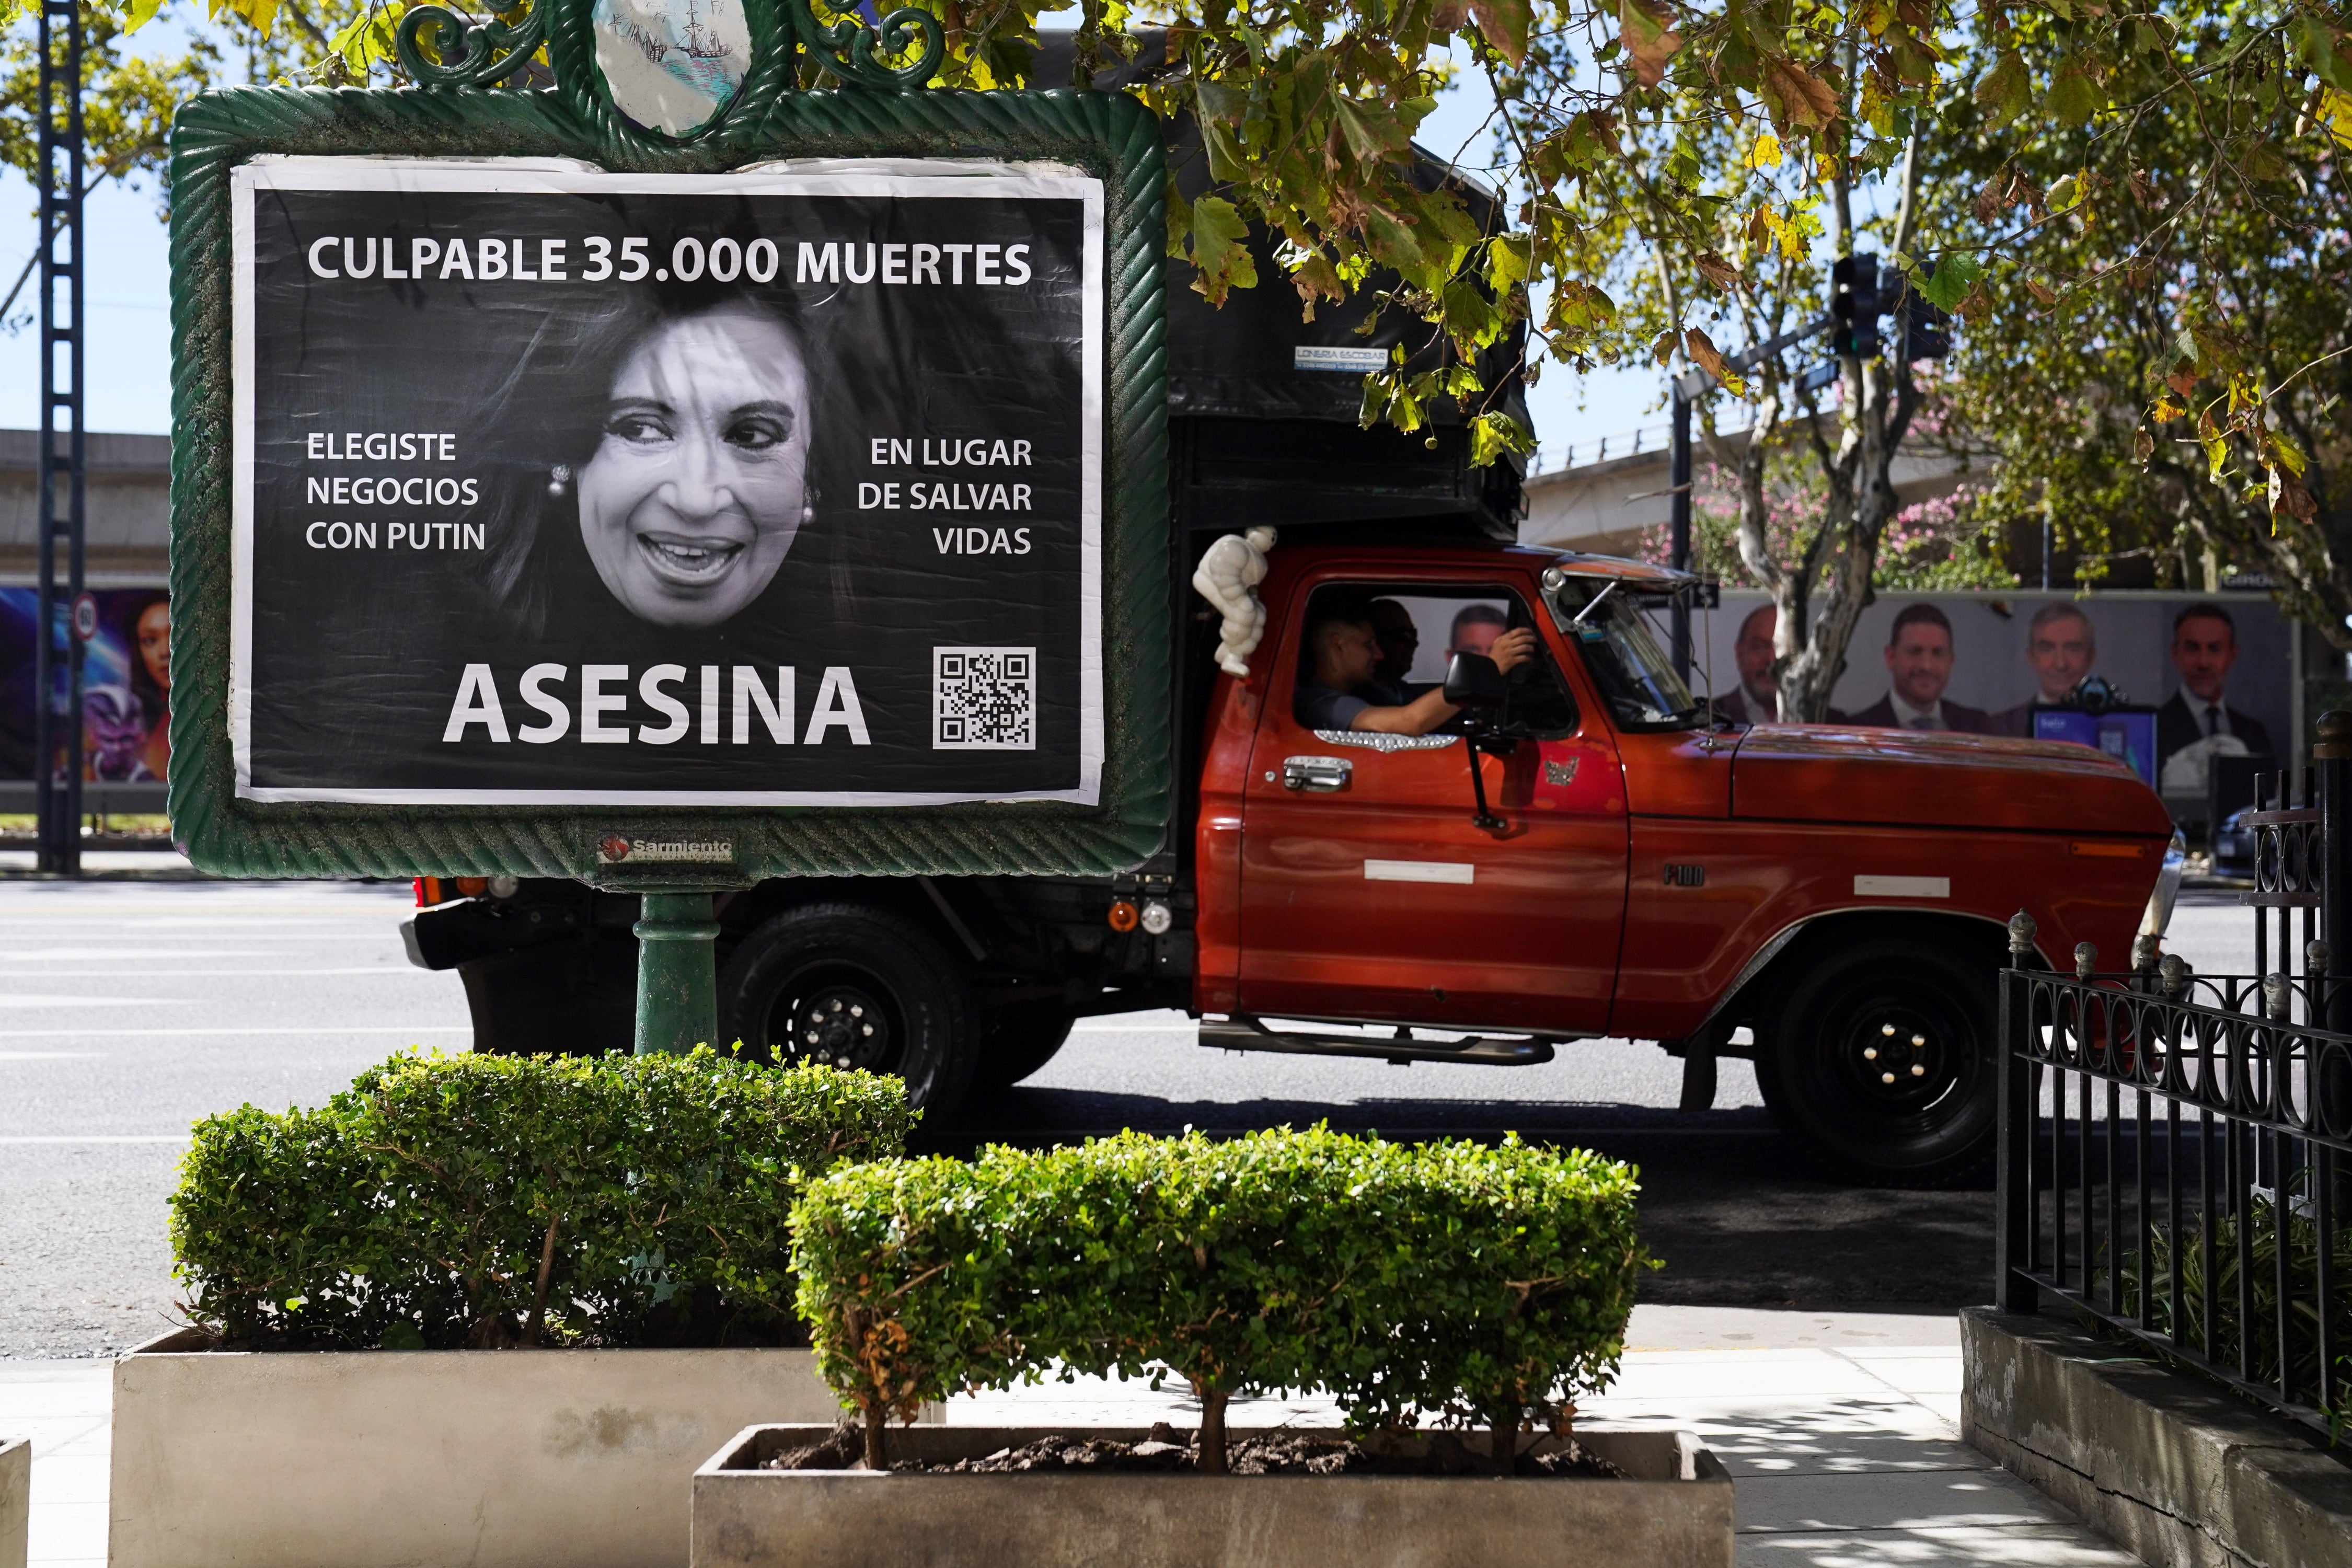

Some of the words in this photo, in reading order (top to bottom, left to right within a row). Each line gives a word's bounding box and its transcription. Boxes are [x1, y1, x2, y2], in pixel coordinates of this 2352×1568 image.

[308, 236, 567, 281] CULPABLE
[581, 236, 779, 283] 35.000
[796, 241, 1032, 286] MUERTES
[307, 432, 456, 461] ELEGISTE
[871, 437, 913, 465] EN
[923, 438, 1032, 466] LUGAR
[307, 476, 479, 506] NEGOCIOS
[858, 482, 901, 510] DE
[909, 482, 1032, 511] SALVAR
[305, 521, 377, 549] CON
[387, 522, 485, 550] PUTIN
[932, 527, 1031, 555] VIDAS
[442, 662, 872, 745] ASESINA
[633, 839, 732, 852] Sarmiento
